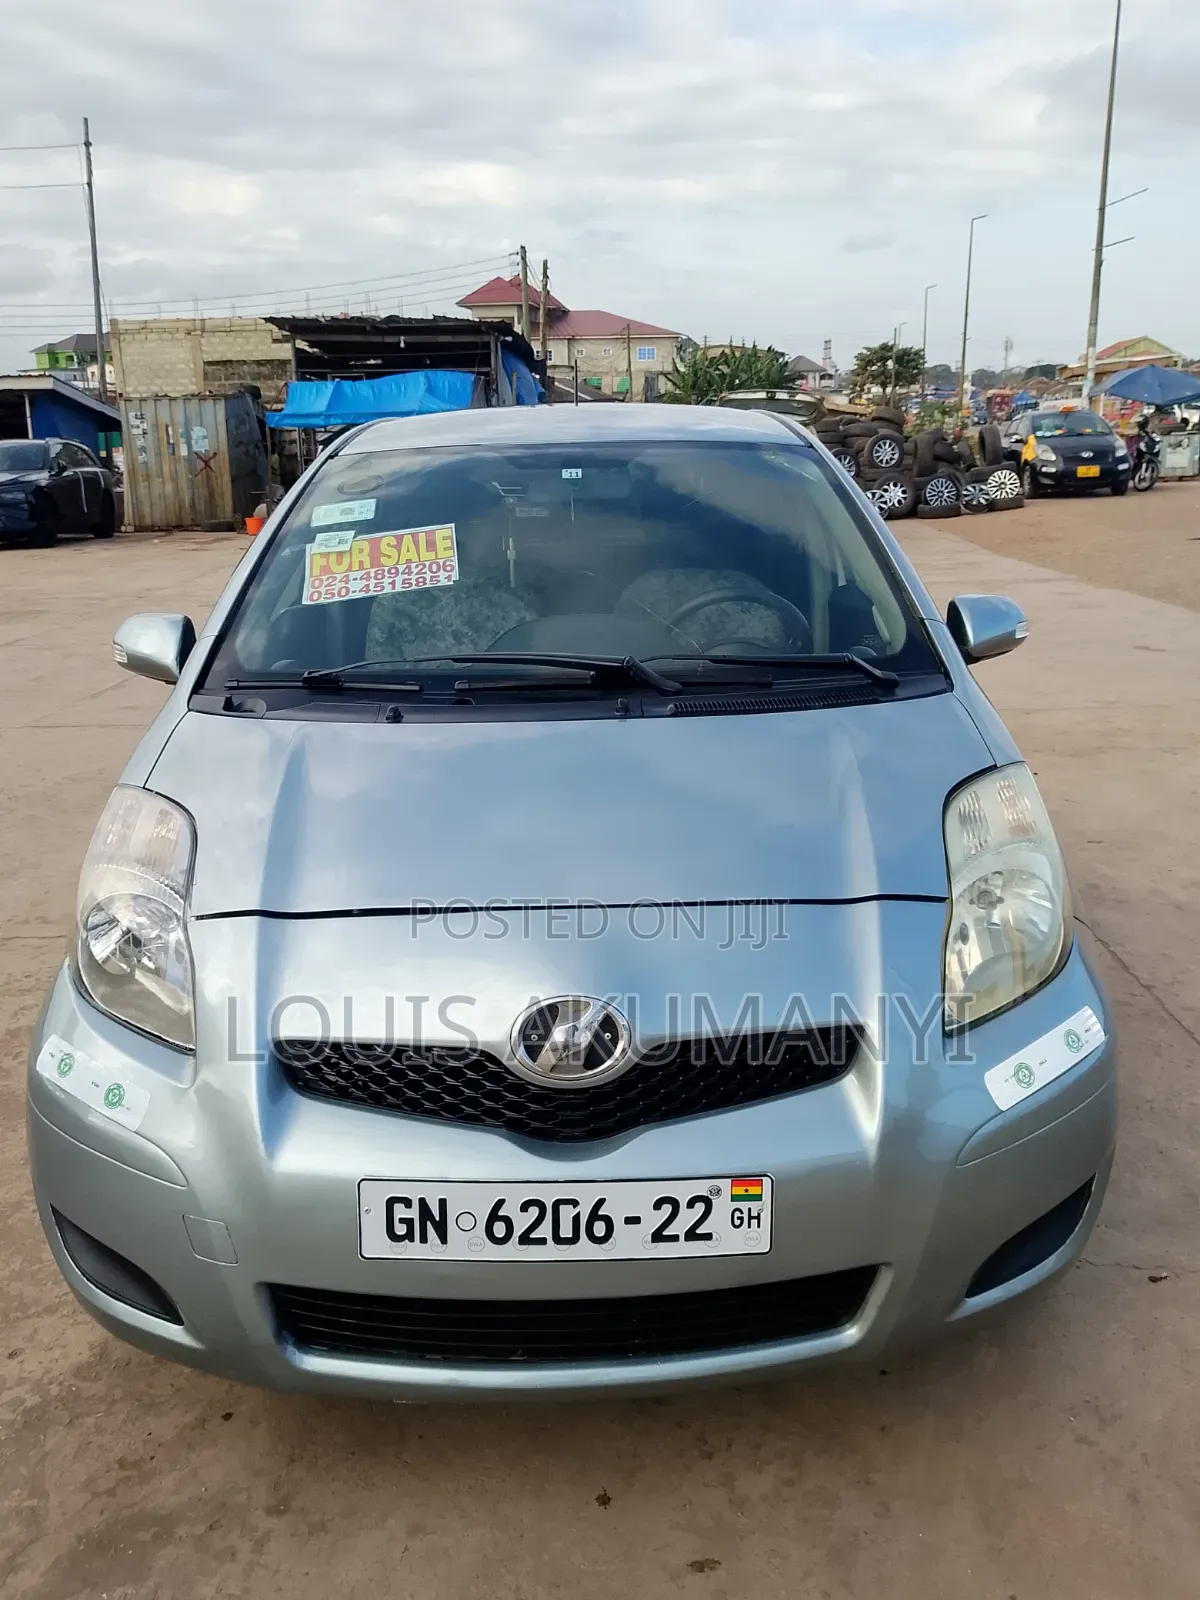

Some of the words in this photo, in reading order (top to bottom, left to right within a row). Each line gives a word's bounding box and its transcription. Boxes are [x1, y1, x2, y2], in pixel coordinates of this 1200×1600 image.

[312, 540, 371, 577] FOR
[380, 528, 454, 567] SALE
[308, 574, 453, 603] 050-4515851
[310, 558, 455, 590] 024-4894206
[385, 1195, 448, 1245] GN
[730, 1207, 761, 1229] GH
